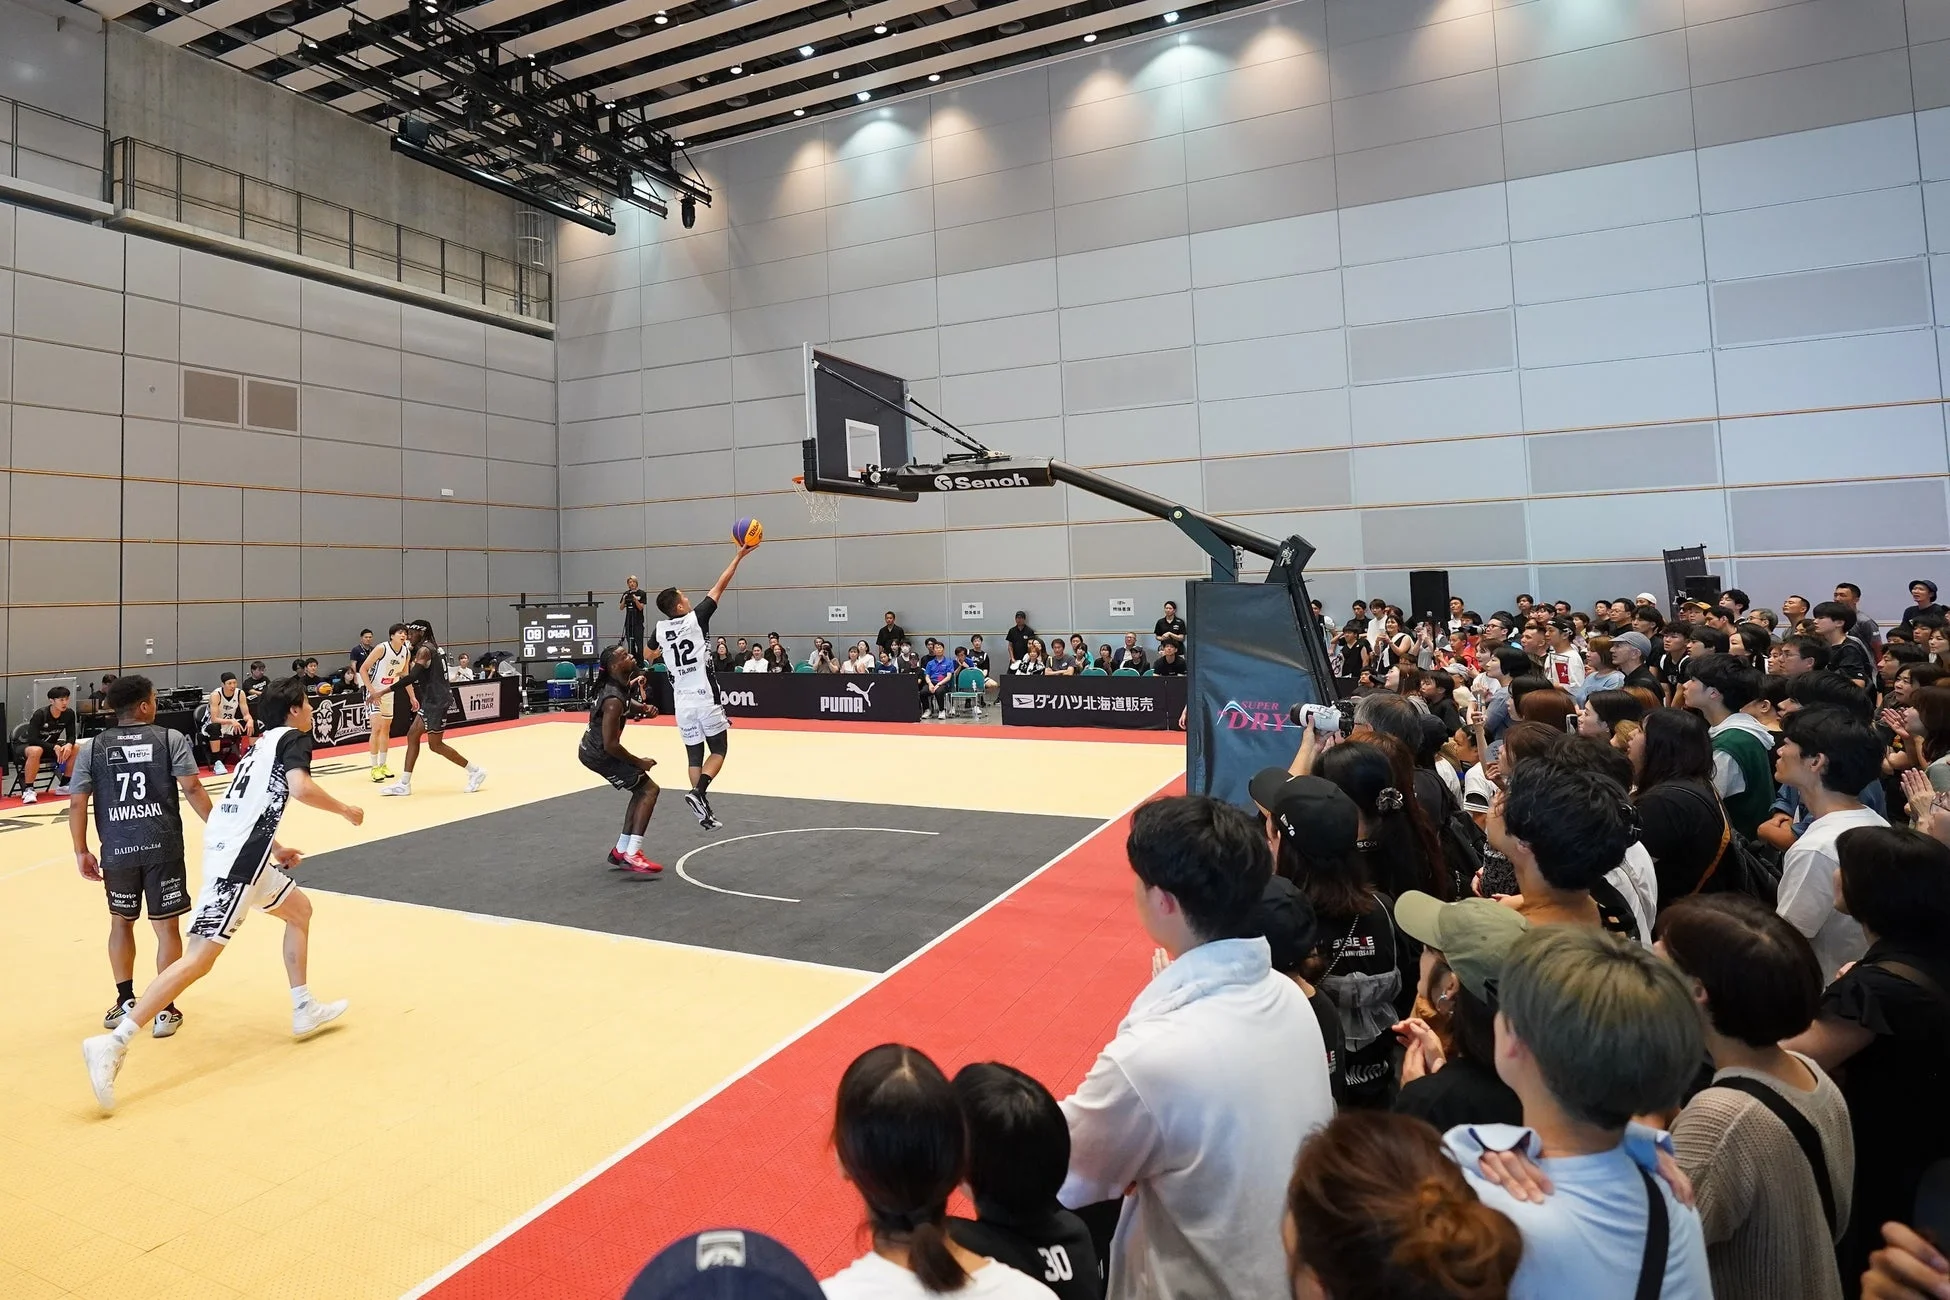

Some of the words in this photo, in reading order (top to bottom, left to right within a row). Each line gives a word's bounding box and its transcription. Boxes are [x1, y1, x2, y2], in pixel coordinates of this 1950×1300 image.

[955, 473, 1030, 489] Senoh
[670, 639, 698, 668] 12
[820, 697, 863, 713] PUMA
[1036, 694, 1154, 712] ダイハツ北海道販売
[1241, 702, 1279, 711] SUPER
[1227, 711, 1290, 732] DRY
[116, 771, 147, 802] 73
[225, 761, 255, 799] 14
[108, 803, 163, 822] KAWASAKI
[114, 845, 140, 855] DAIDO
[1037, 1244, 1073, 1282] 30
